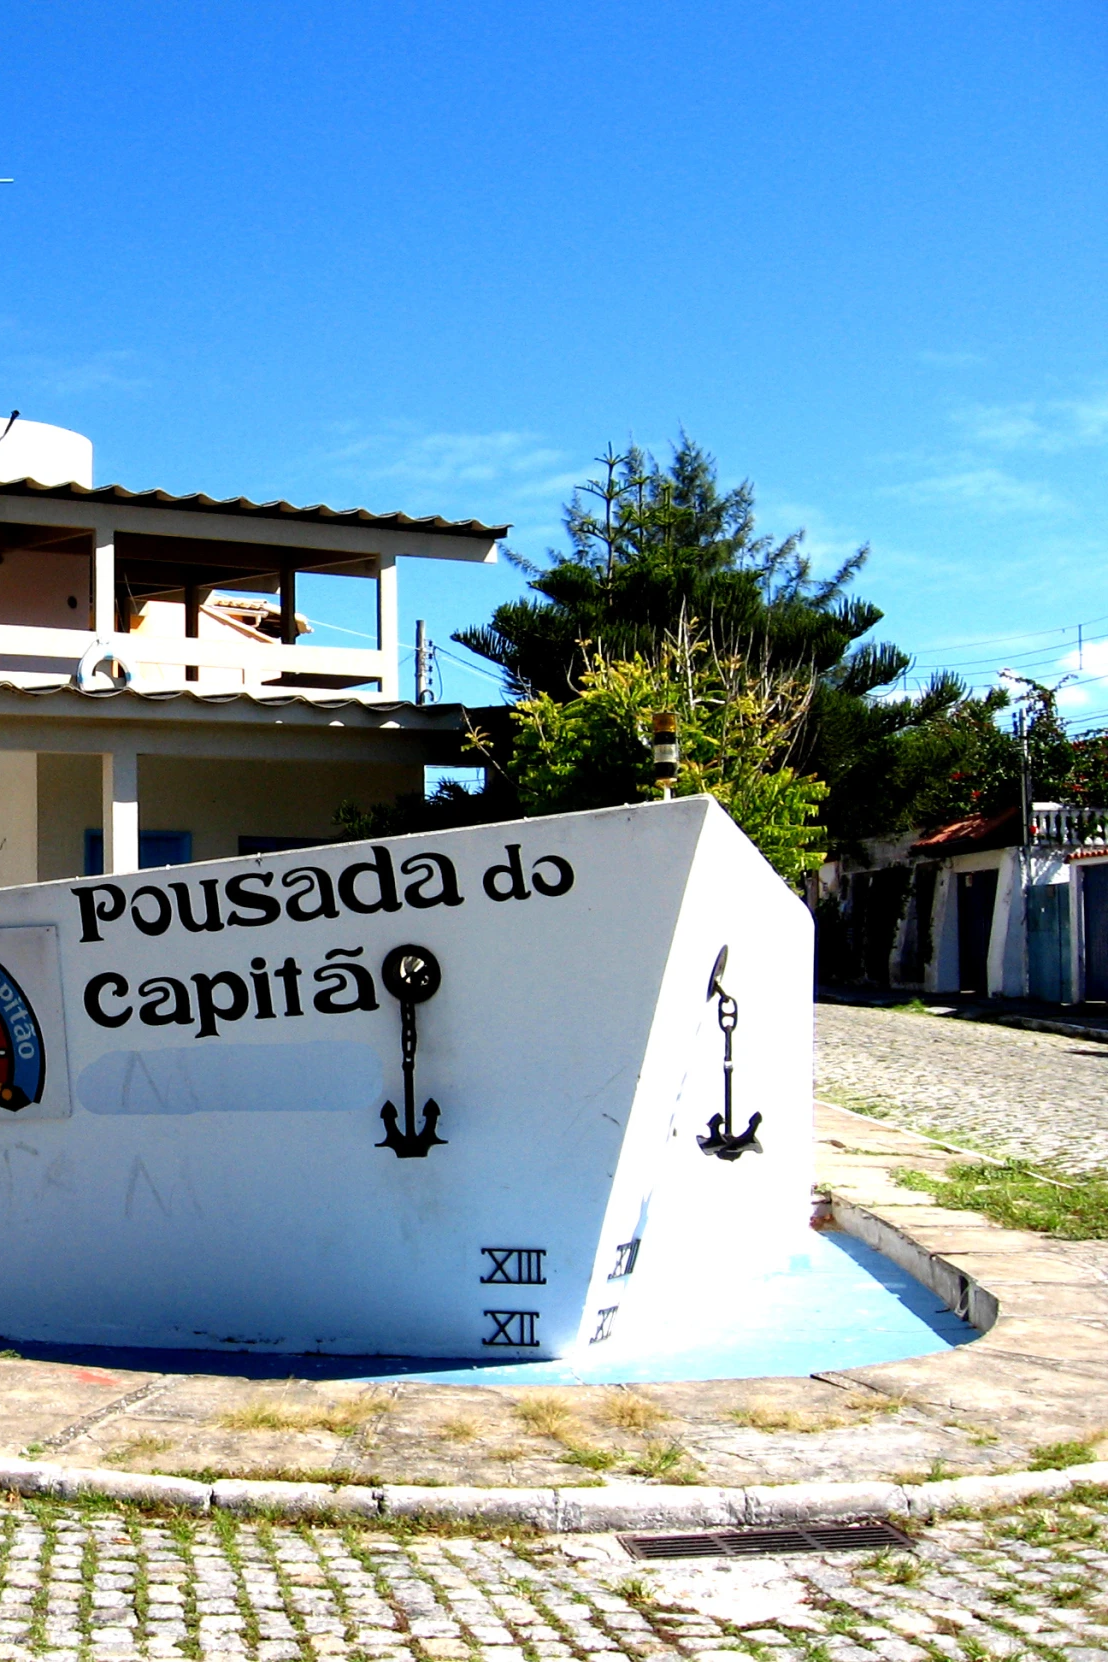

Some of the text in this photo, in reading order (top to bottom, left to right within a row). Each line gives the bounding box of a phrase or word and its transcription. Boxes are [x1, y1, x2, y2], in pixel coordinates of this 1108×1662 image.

[482, 843, 575, 902] do
[480, 1247, 547, 1285] XIII
[481, 1309, 540, 1348] XII
